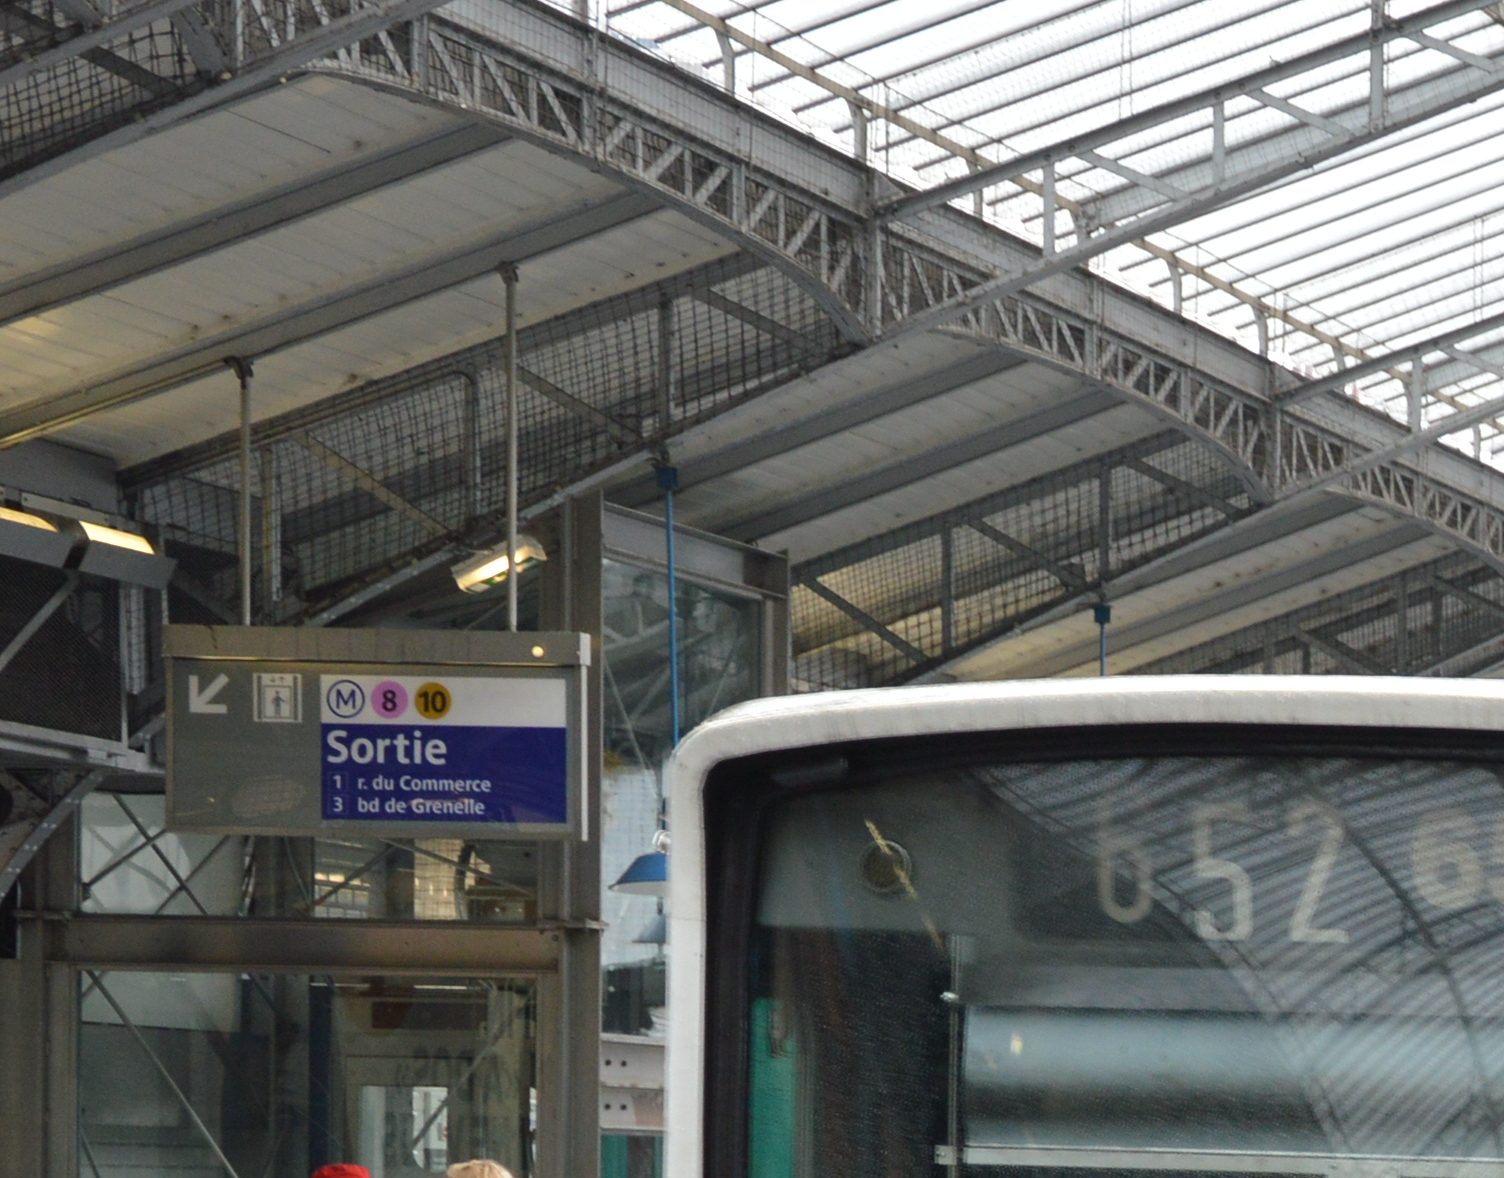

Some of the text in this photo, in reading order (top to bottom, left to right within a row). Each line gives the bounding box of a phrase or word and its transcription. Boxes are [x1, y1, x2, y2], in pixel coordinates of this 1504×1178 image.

[420, 690, 446, 712] 10
[326, 730, 448, 766] Sortie
[357, 778, 368, 790] r.
[373, 775, 393, 791] du
[400, 776, 492, 793] Commerce
[358, 796, 379, 813] bd
[386, 797, 407, 814] de
[412, 798, 486, 815] Grenelle
